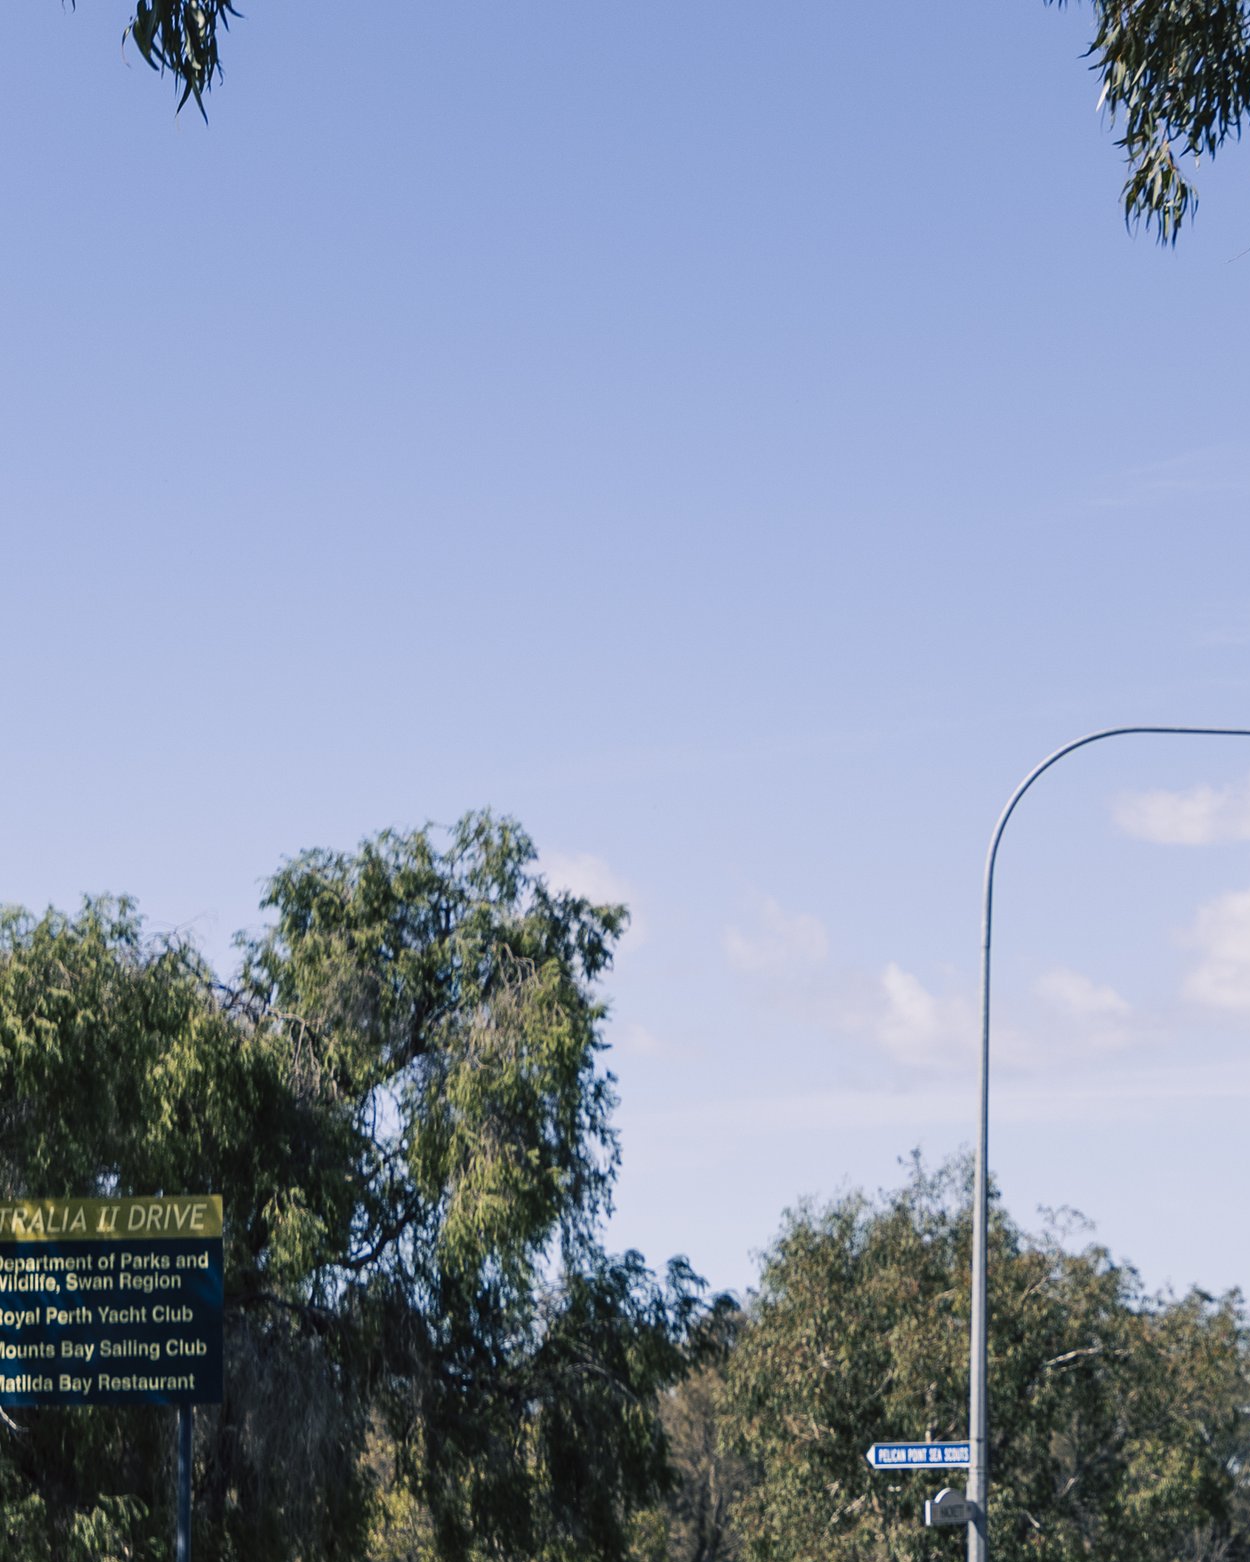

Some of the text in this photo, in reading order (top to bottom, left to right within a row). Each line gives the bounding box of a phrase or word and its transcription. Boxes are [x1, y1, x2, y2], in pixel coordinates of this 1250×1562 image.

[128, 1203, 207, 1231] DRIVE
[98, 1253, 115, 1270] of
[121, 1252, 170, 1270] Parks
[176, 1251, 209, 1269] and
[66, 1273, 114, 1291] Swan
[119, 1271, 182, 1293] Region
[0, 1304, 193, 1330] oyal Perth Yacht Club
[61, 1340, 95, 1362] Bay
[100, 1339, 160, 1361] Sailing
[165, 1338, 207, 1357] Club
[59, 1374, 93, 1395] Bay
[98, 1372, 195, 1391] Restaurant
[878, 1448, 907, 1463] PELICAN
